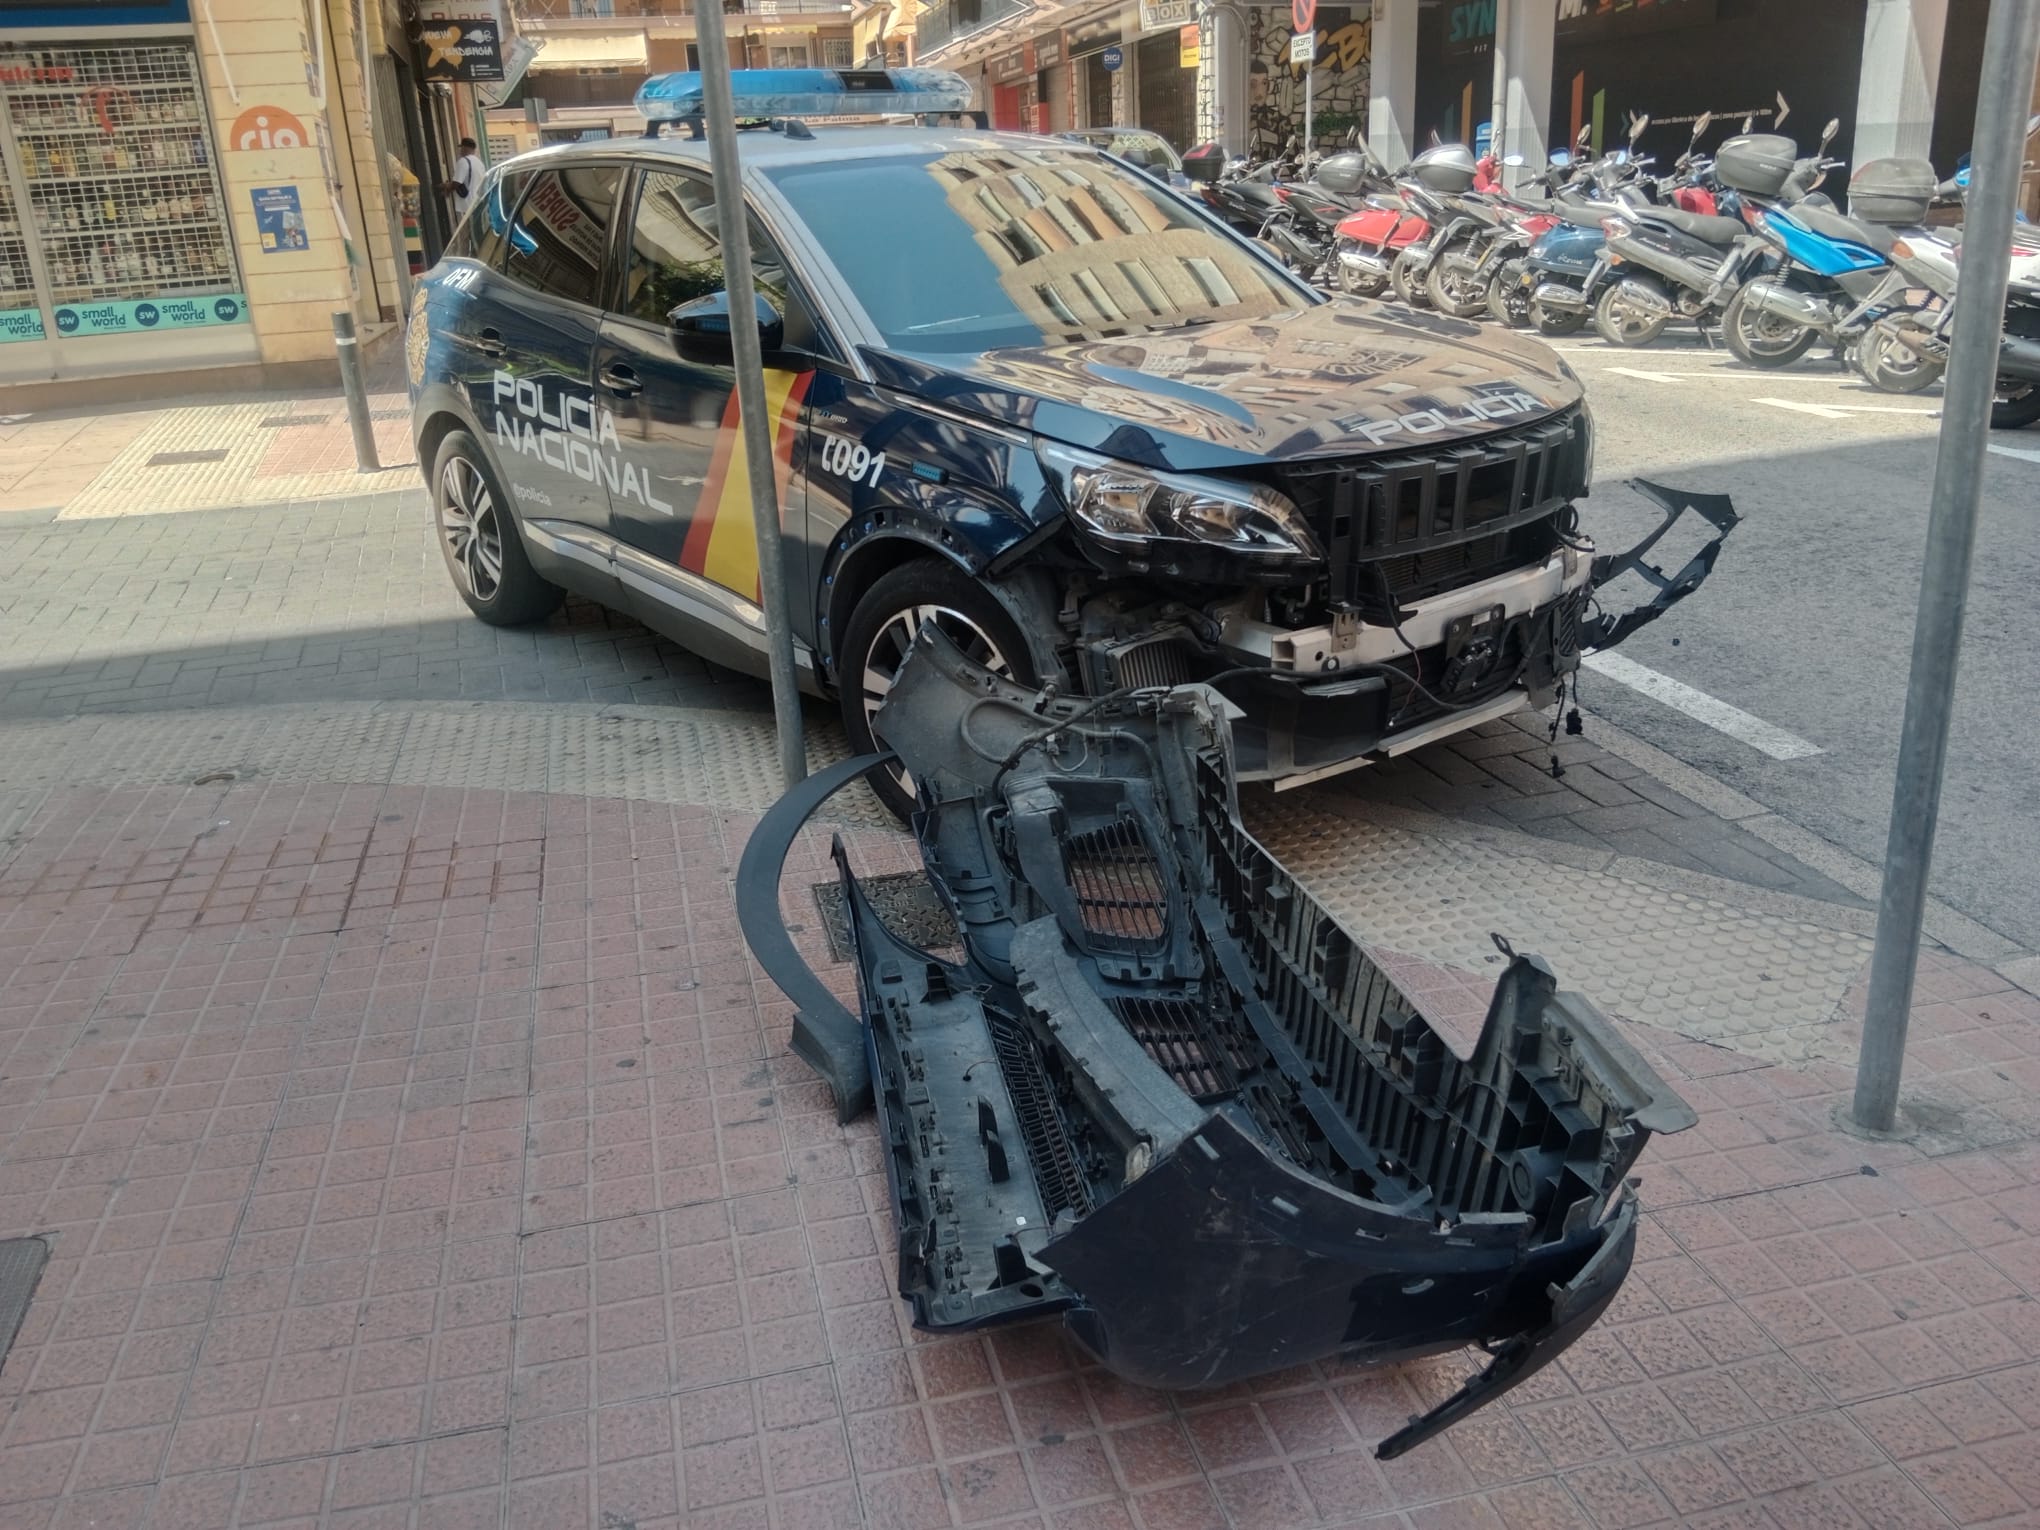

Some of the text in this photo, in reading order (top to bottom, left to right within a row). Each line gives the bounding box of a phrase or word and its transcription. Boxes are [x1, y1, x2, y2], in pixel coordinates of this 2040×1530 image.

[1293, 38, 1312, 48] EXCEPTO
[1104, 54, 1120, 62] DIGI
[1295, 48, 1310, 57] MOTOS
[82, 306, 115, 319] small
[162, 301, 194, 314] small
[0, 313, 31, 327] small
[91, 314, 127, 327] world
[171, 309, 206, 322] world
[494, 369, 622, 452] POLICÍA
[1350, 390, 1549, 446] POLICÍA
[495, 410, 674, 516] NACIONAL
[832, 439, 886, 489] 091
